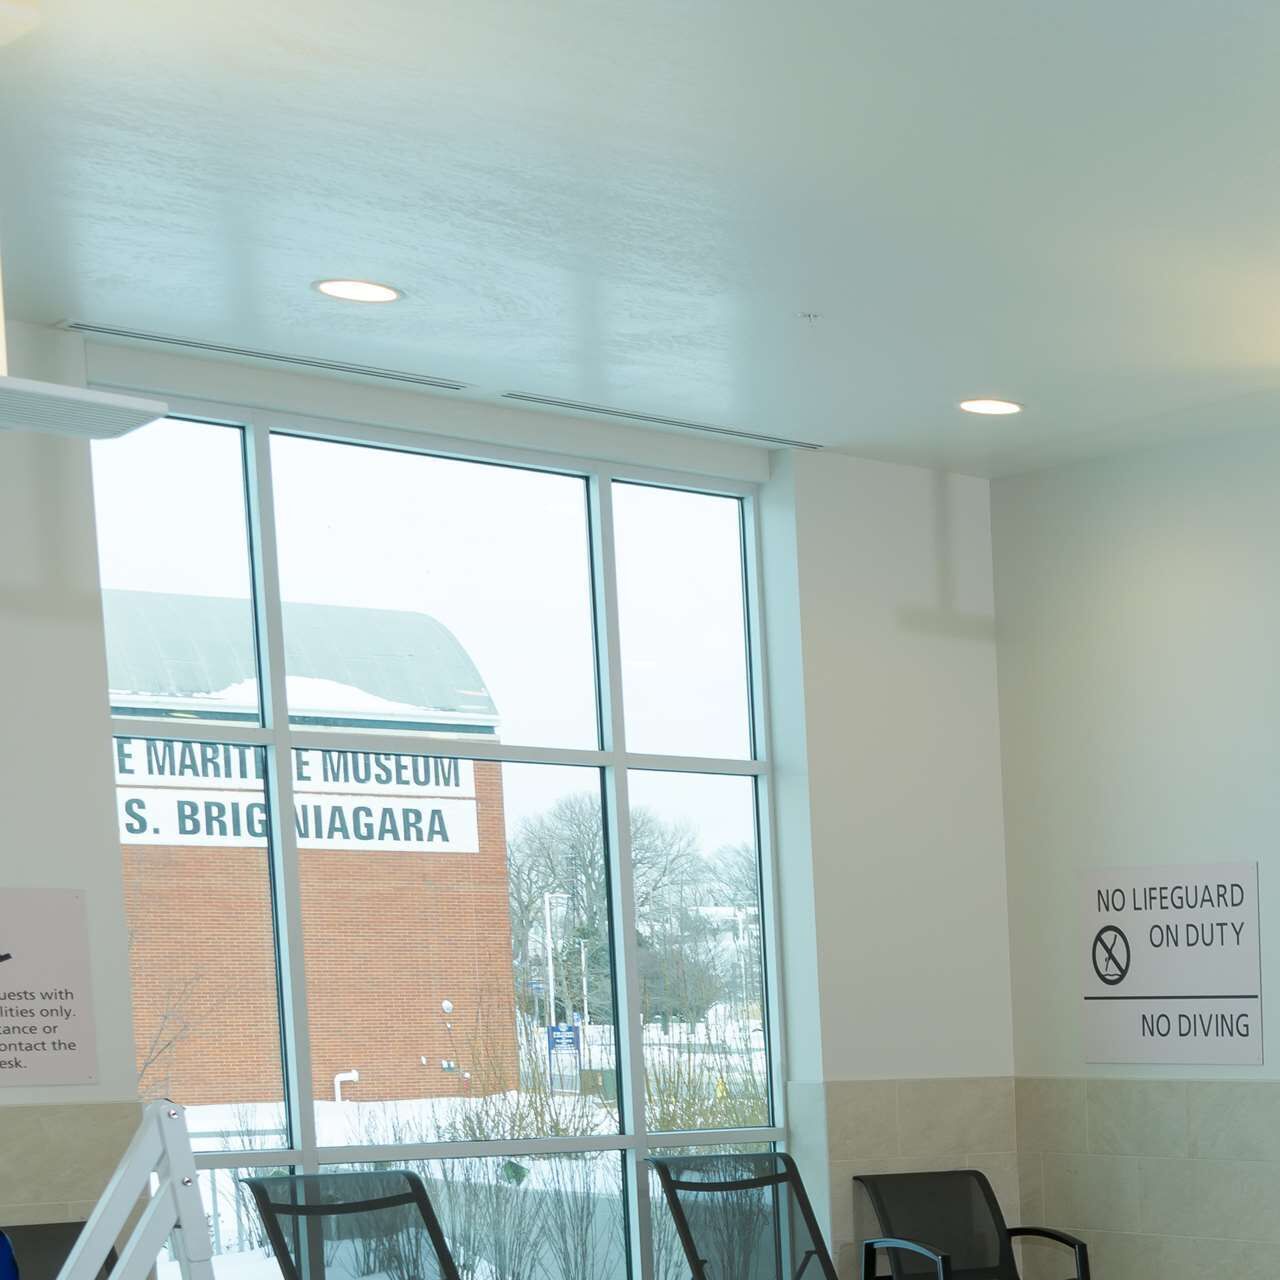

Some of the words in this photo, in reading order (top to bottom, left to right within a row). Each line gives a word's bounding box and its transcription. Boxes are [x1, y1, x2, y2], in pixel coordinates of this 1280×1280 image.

[146, 740, 311, 781] MARITIE
[322, 750, 460, 787] MUSEUM
[177, 800, 268, 838] BRIG
[295, 804, 450, 842] NIAGARA
[1097, 888, 1126, 912] NO
[1133, 883, 1244, 911] LIFEGUARD
[1150, 924, 1179, 948] ON
[1186, 922, 1245, 947] DUTY
[40, 988, 74, 1001] with
[40, 1006, 76, 1020] only.
[1142, 1014, 1171, 1037] NO
[1178, 1013, 1250, 1037] DIVING
[43, 1025, 59, 1035] or
[0, 1041, 47, 1052] ontact
[51, 1040, 77, 1051] the
